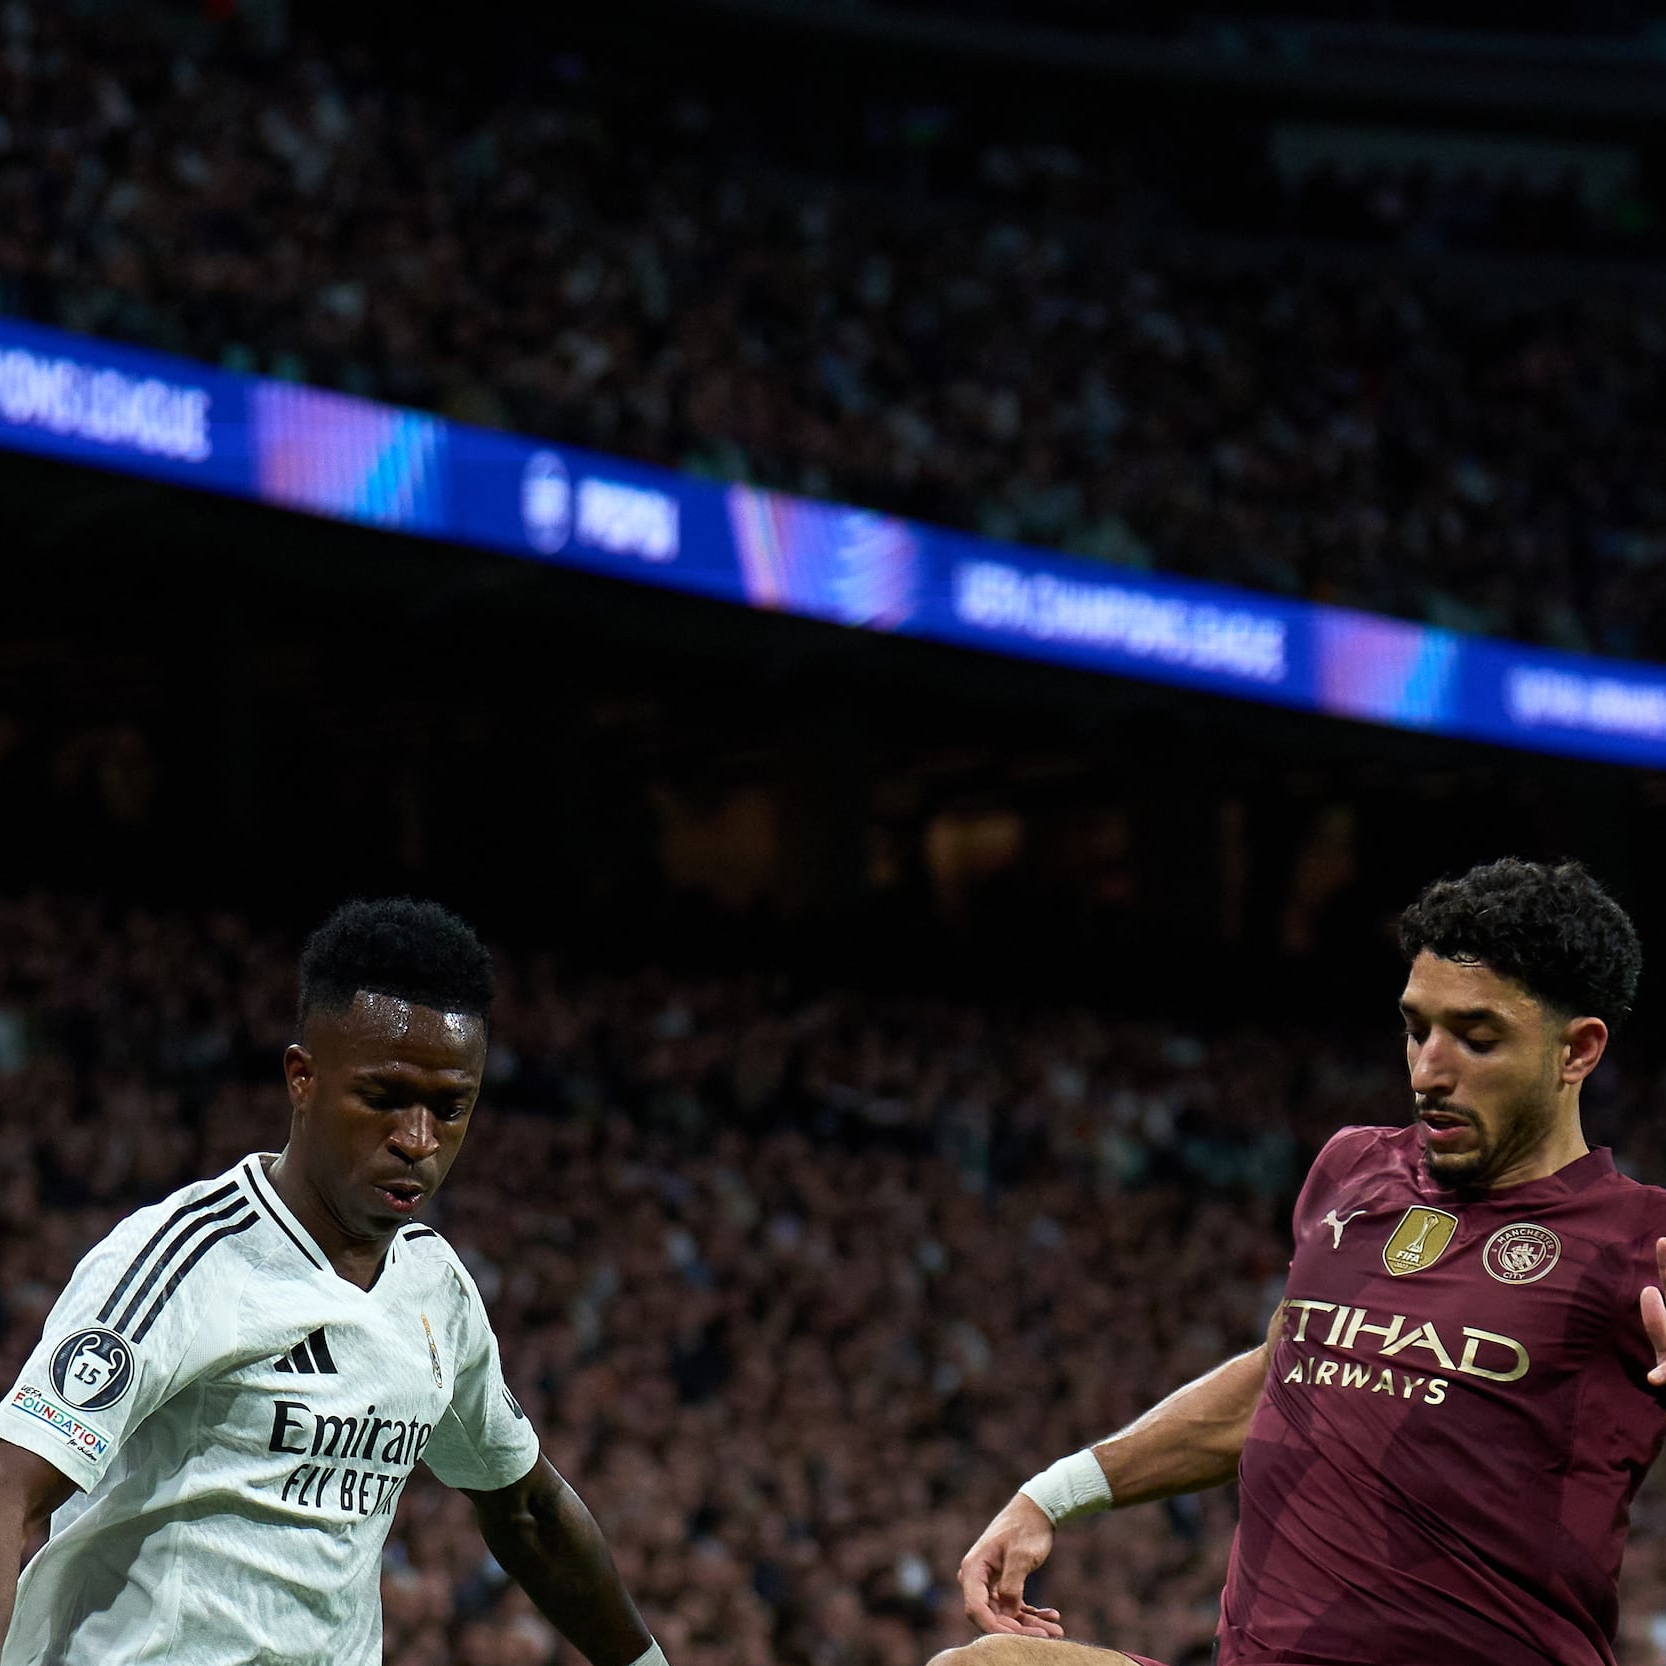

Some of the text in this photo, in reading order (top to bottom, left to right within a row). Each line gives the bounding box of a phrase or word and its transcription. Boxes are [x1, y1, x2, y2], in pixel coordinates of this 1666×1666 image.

[1497, 1229, 1555, 1250] MANCHESTER
[1395, 1251, 1421, 1263] FIFA
[1502, 1272, 1525, 1280] CITY
[74, 1362, 101, 1385] 15
[1284, 1357, 1449, 1405] AIRWAYS
[20, 1384, 42, 1399] UEFA
[13, 1391, 107, 1454] FOUNDATION
[269, 1400, 436, 1466] Emirate
[282, 1463, 336, 1508] FLY
